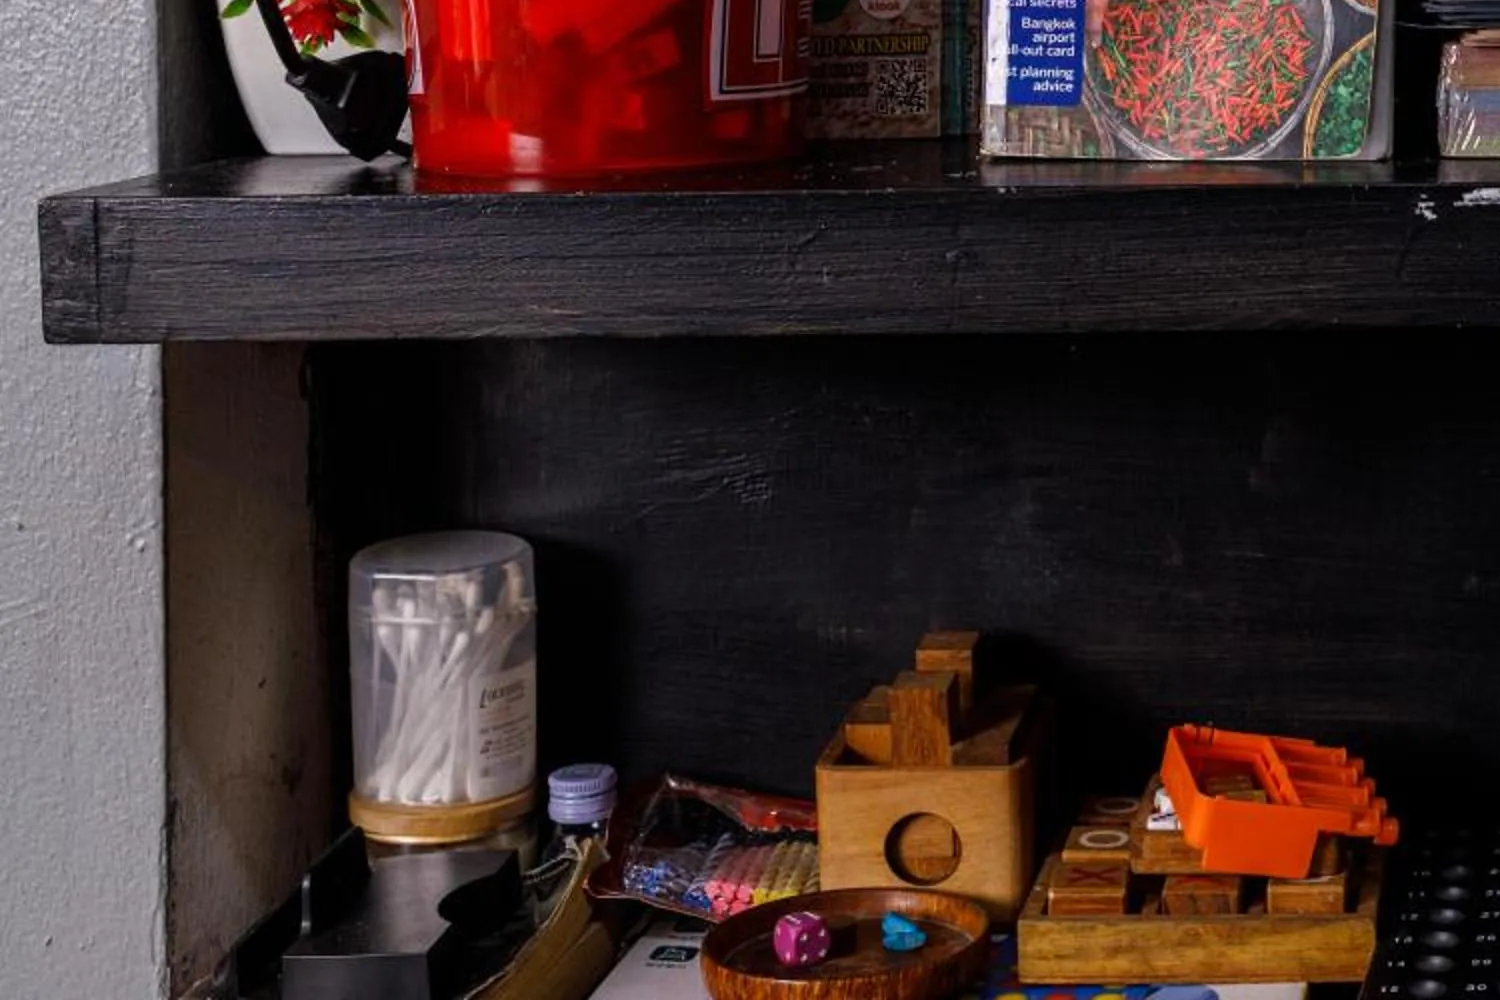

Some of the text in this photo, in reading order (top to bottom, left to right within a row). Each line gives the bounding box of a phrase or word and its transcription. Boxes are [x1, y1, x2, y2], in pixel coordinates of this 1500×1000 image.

[1021, 17, 1075, 31] Bangkok
[1032, 32, 1075, 45] airport
[1047, 45, 1075, 56] card
[1020, 67, 1075, 80] planning
[1032, 81, 1075, 92] advice
